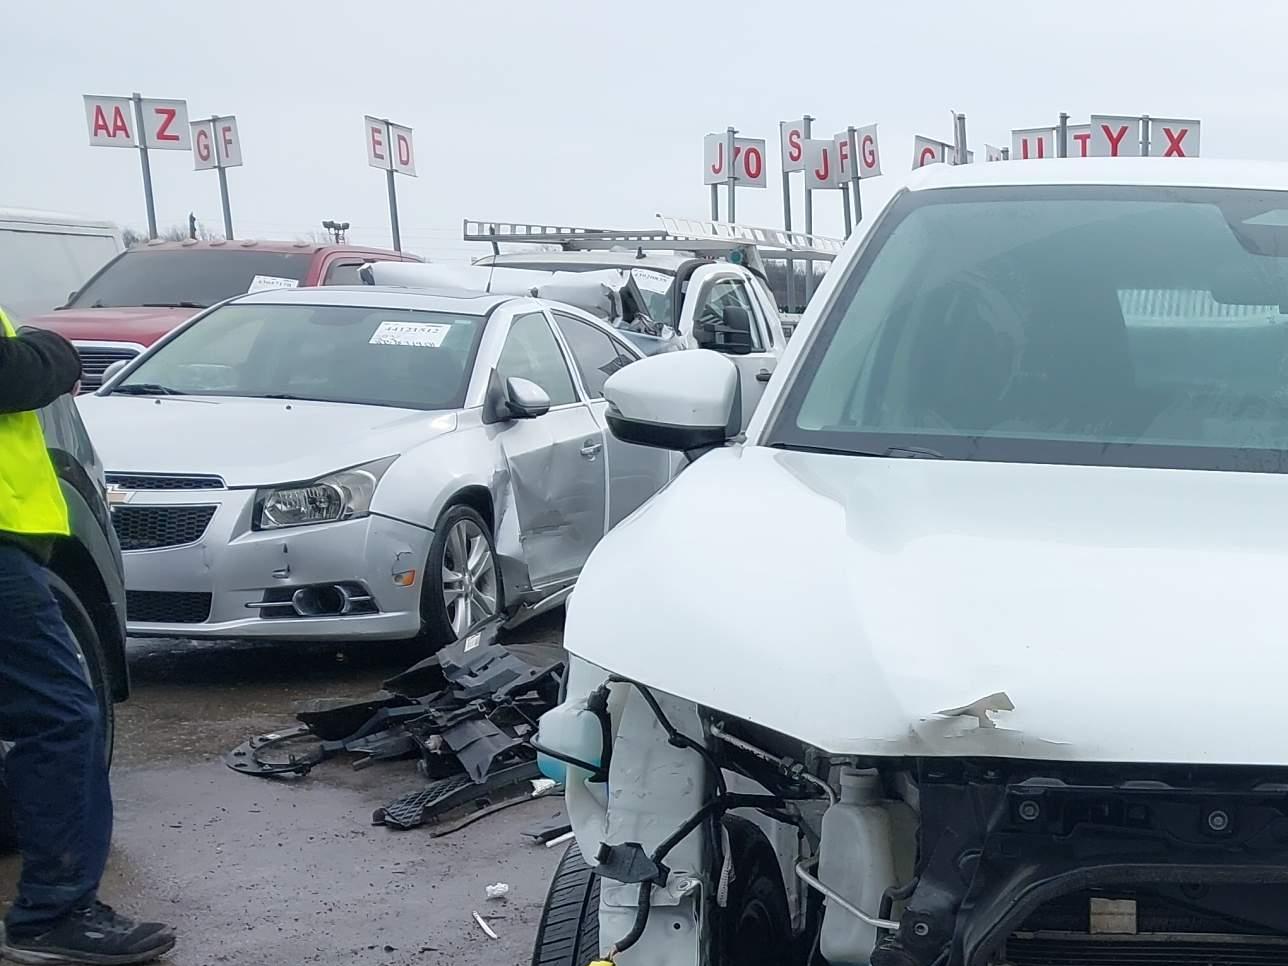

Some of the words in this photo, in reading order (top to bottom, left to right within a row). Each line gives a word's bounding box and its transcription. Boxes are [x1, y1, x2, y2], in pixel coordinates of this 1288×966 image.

[93, 104, 131, 139] AA
[154, 108, 181, 141] Z
[196, 128, 211, 161] G
[221, 126, 233, 158] F
[370, 128, 385, 160] E
[397, 134, 410, 166] D
[788, 129, 802, 162] S
[862, 134, 876, 169] G
[1100, 125, 1129, 157] Y
[1162, 128, 1189, 157] X
[711, 142, 723, 175] J
[814, 148, 829, 181] J
